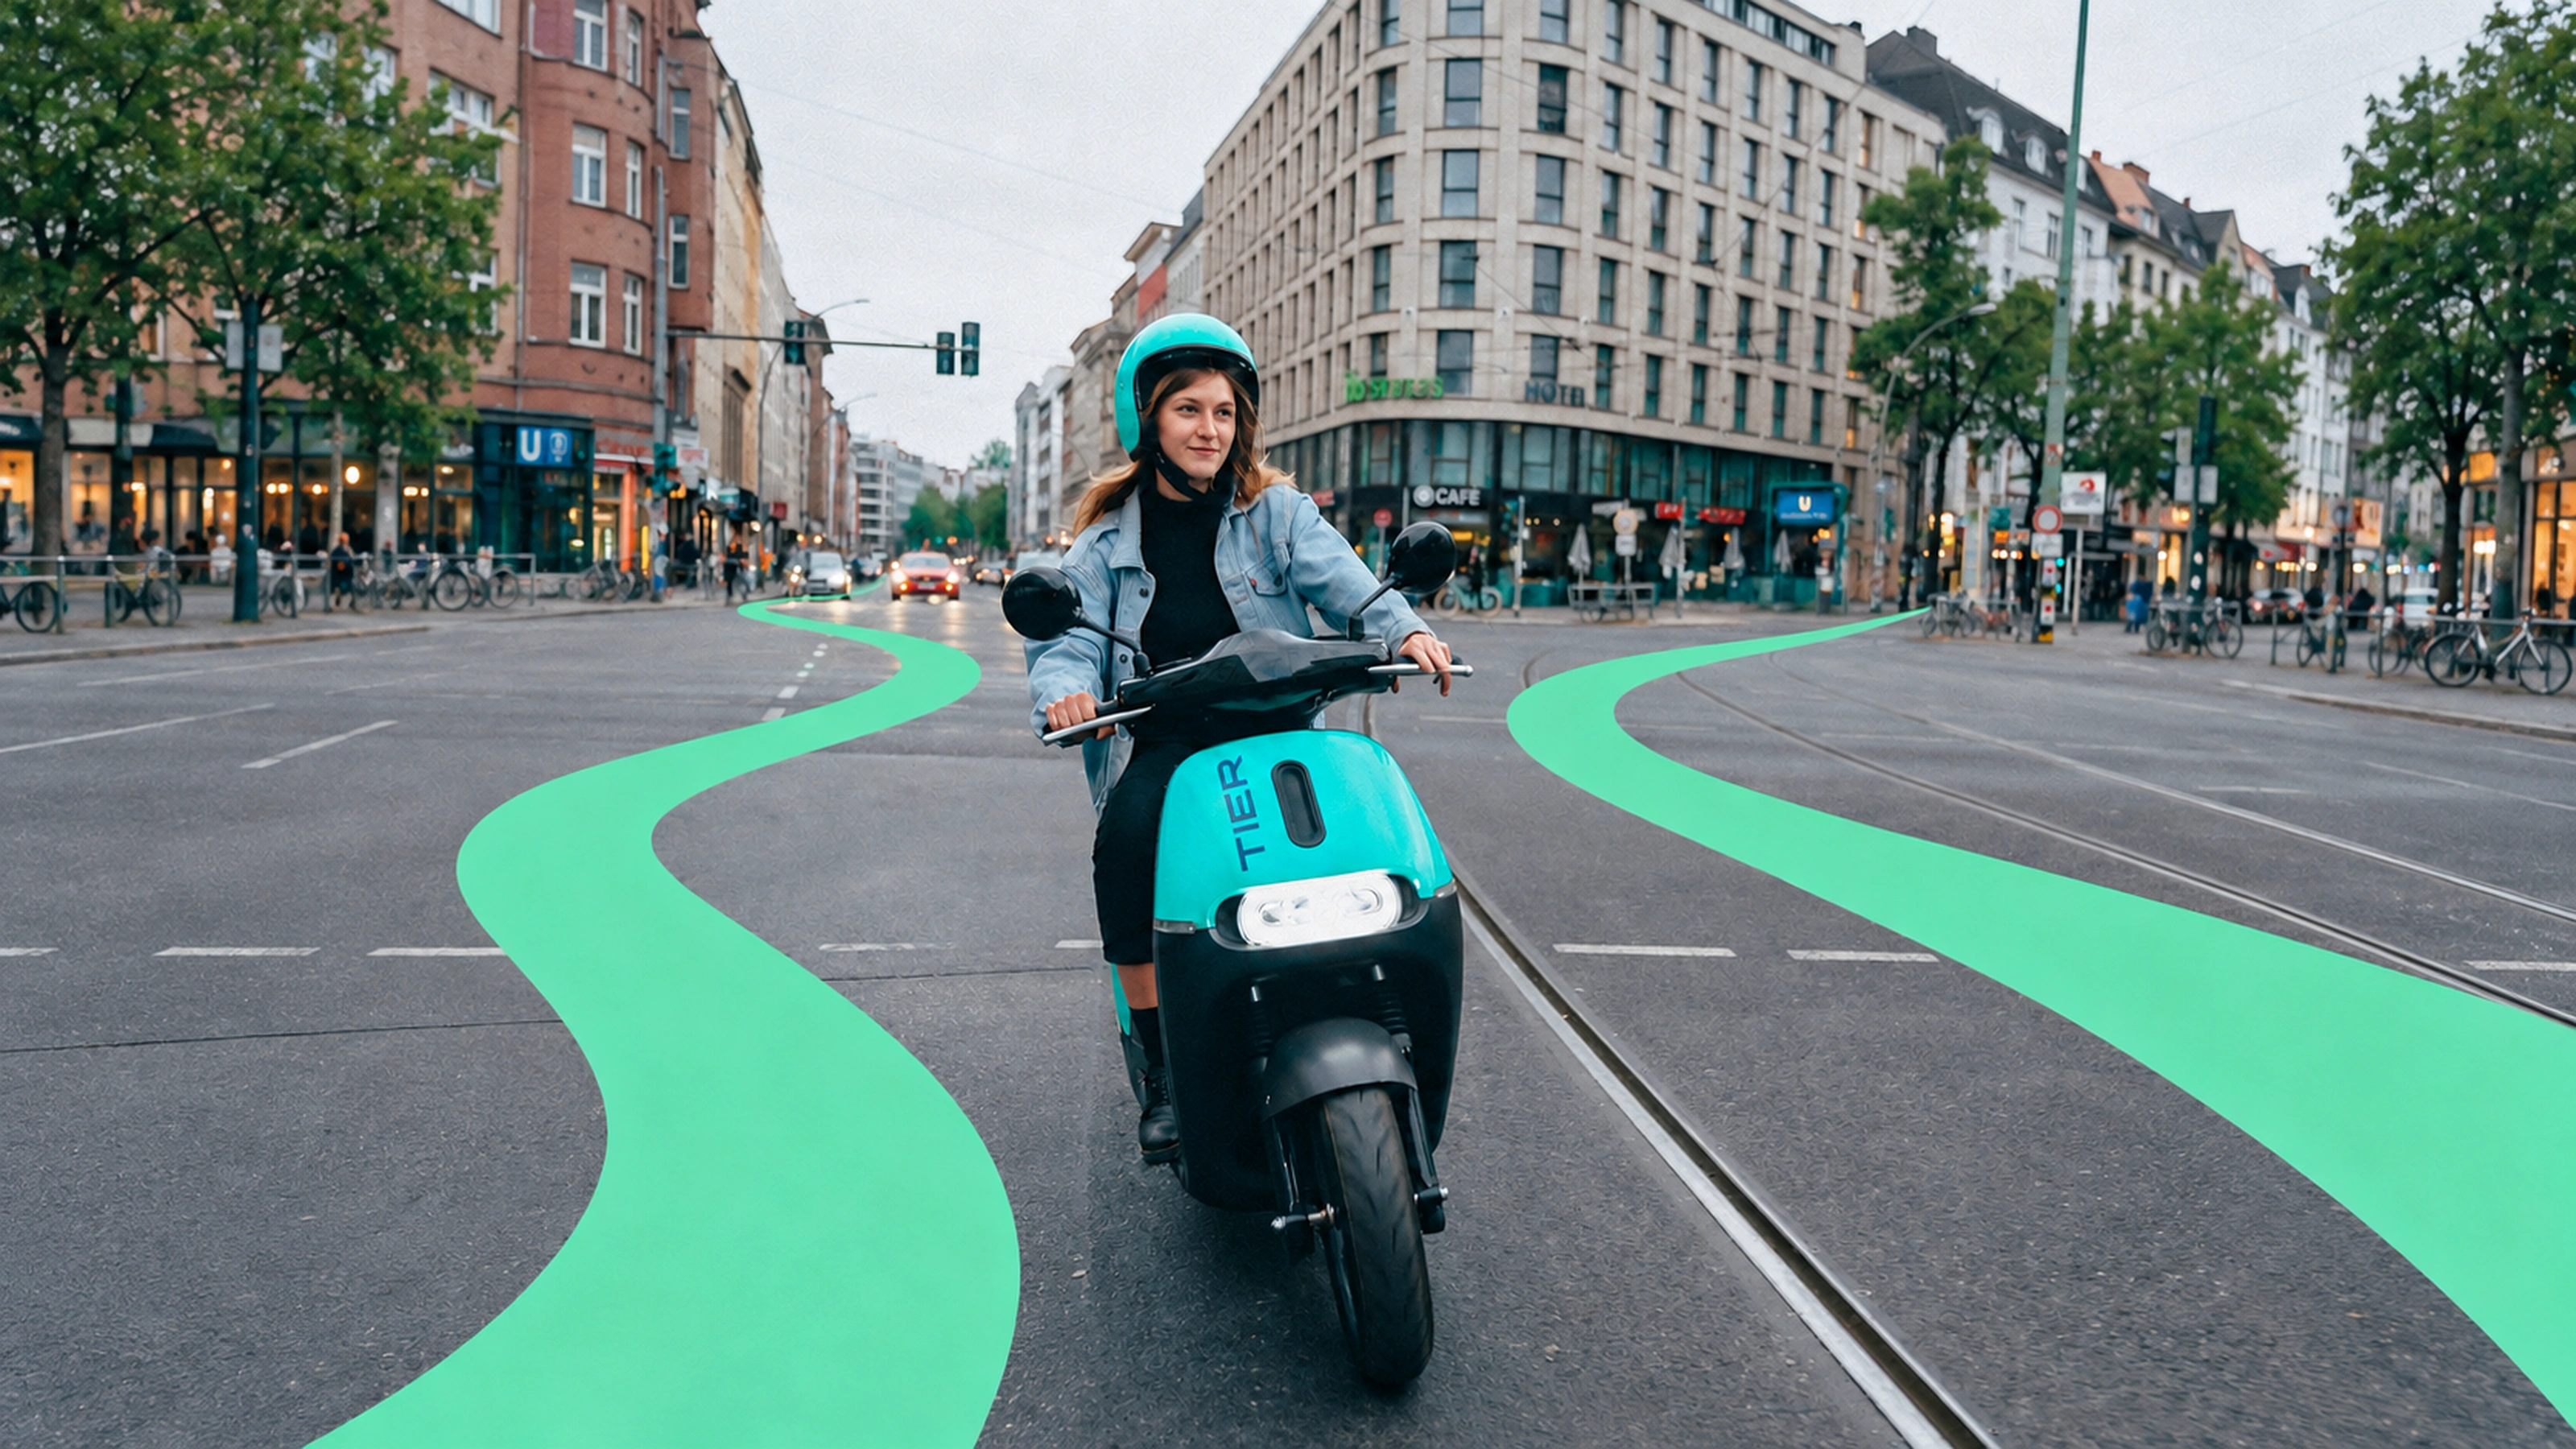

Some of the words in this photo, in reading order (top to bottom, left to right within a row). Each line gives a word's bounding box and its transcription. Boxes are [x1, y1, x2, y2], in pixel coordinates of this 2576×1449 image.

[521, 428, 542, 462] U
[1798, 495, 1811, 512] U
[1217, 755, 1265, 871] TIER
